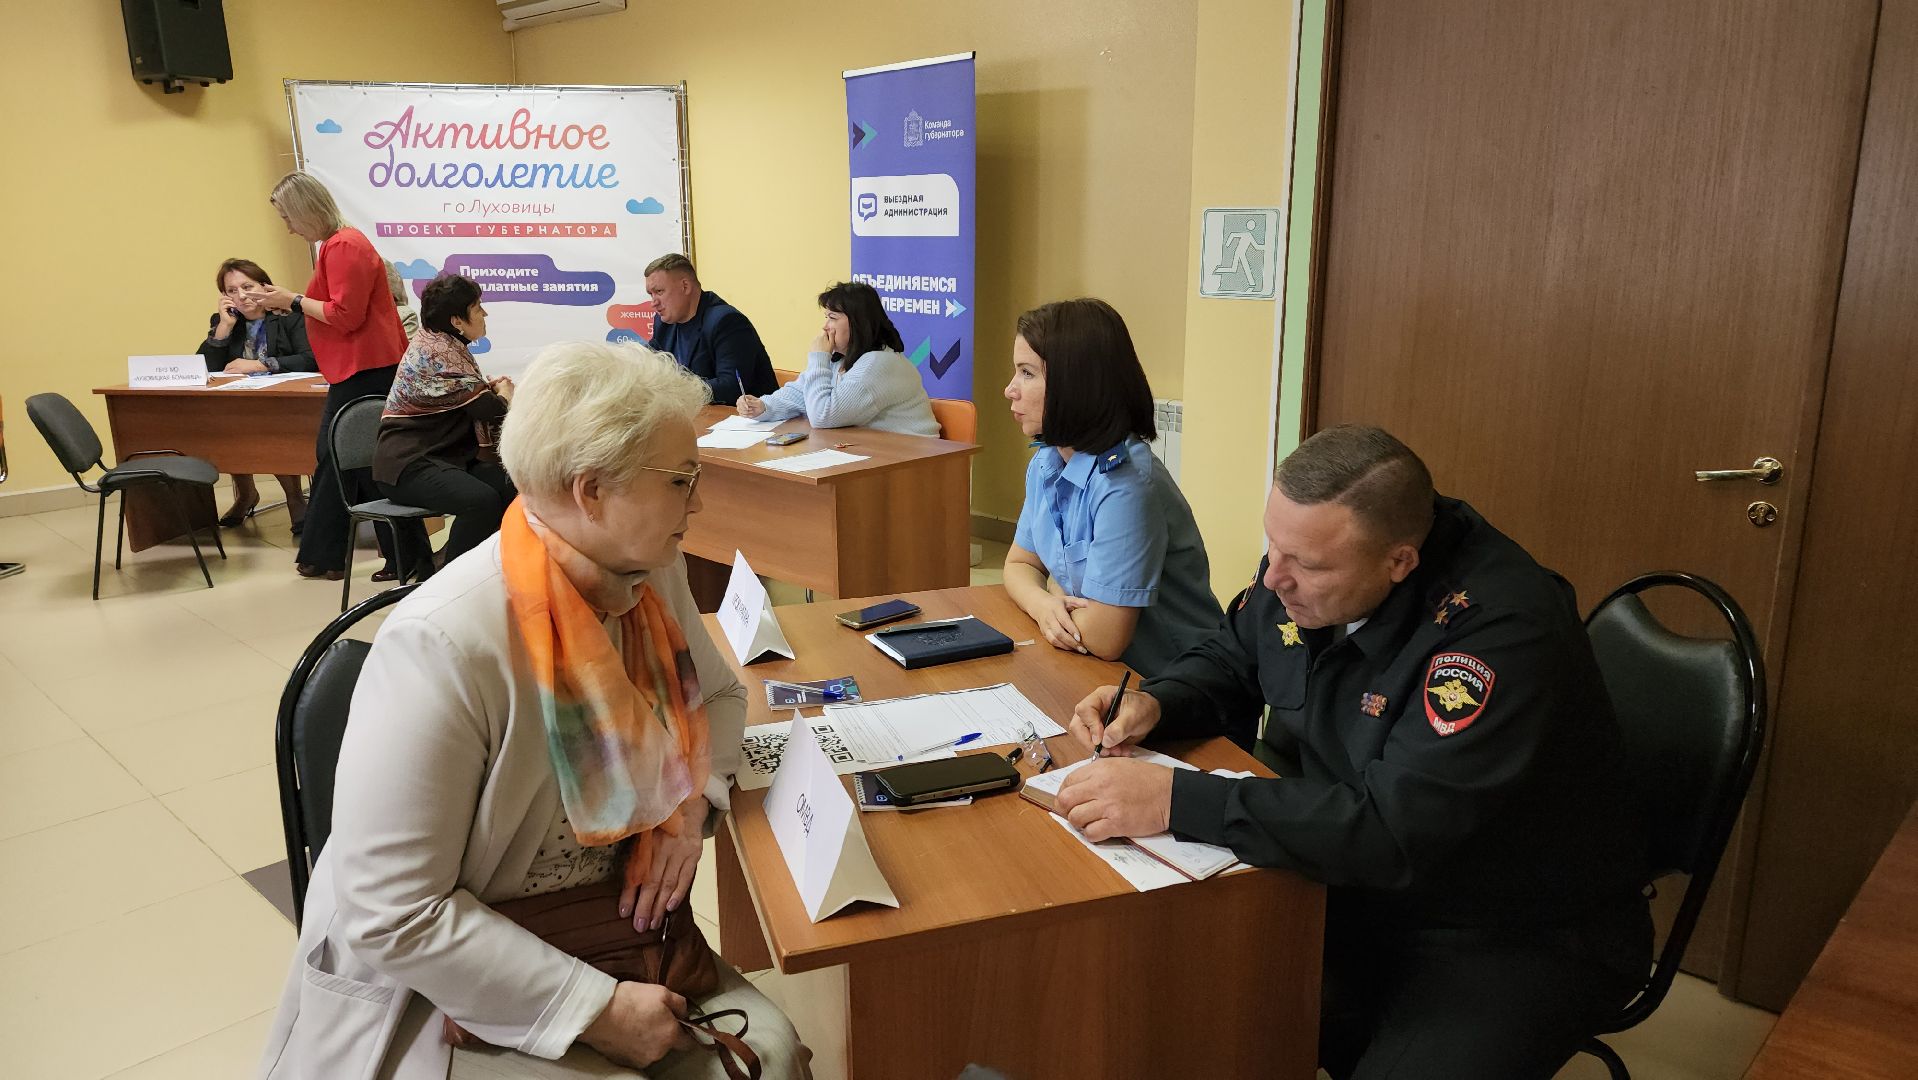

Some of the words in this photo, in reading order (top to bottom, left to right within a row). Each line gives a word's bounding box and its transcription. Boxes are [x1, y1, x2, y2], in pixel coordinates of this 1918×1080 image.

[364, 105, 610, 150] Активное
[925, 120, 952, 130] Команда
[925, 129, 965, 141] губернатора
[369, 143, 619, 188] долголетие
[884, 195, 924, 204] ВЫЕЗДНАЯ
[468, 199, 555, 218] Луховицы
[884, 208, 948, 217] АДМИНИСТРАЦИЯ
[383, 224, 457, 236] ПРОЕКТ
[475, 224, 612, 236] ГУБЕРНАТОРА
[459, 265, 539, 279] Приходите
[478, 282, 539, 292] платные
[542, 283, 599, 292] занятия
[852, 273, 957, 293] ОБЪЕДИНЯЕМСЯ
[881, 296, 940, 315] ПЕРЕМЕН
[620, 311, 657, 320] женщи
[1435, 655, 1491, 682] ПОЛИЦИЯ
[1434, 668, 1484, 692] РОССИЯ
[1433, 716, 1456, 735] МВД
